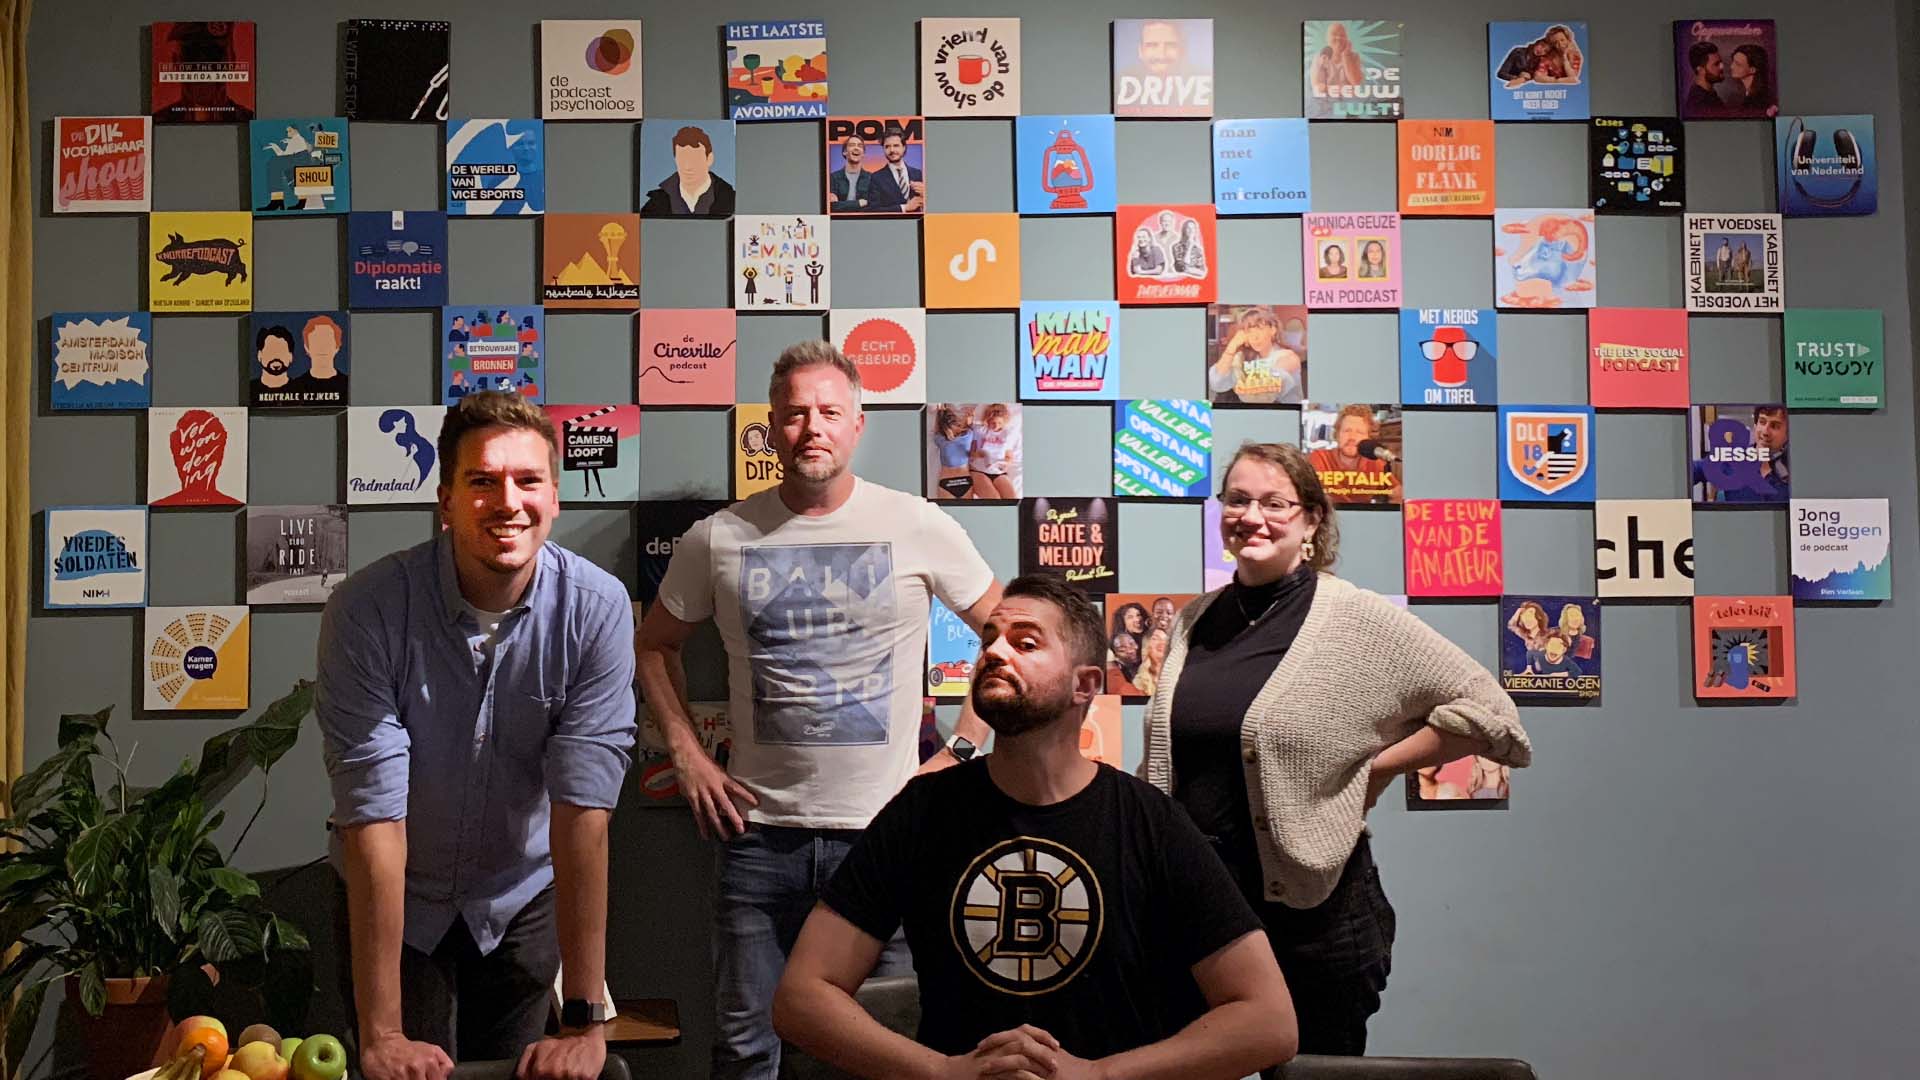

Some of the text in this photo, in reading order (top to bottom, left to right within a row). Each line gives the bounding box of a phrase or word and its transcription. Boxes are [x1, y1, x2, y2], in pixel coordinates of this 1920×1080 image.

[730, 23, 824, 38] HET LAATSTE
[935, 27, 1010, 109] vriend van de show
[1365, 67, 1400, 81] DE
[550, 75, 568, 87] de
[550, 87, 612, 101] podcast
[1117, 75, 1212, 105] DRIVE
[1313, 84, 1400, 98] LEEUW
[550, 98, 635, 112] psycholoog
[733, 104, 826, 119] AVONDMAAL
[1333, 102, 1400, 116] LULT!
[1595, 119, 1624, 127] Cases
[84, 122, 123, 145] DIK
[829, 120, 923, 141] POM
[1220, 128, 1256, 138] man
[317, 134, 336, 146] SIDE
[62, 141, 145, 160] VOORMEKAAR
[1220, 149, 1252, 160] met
[1412, 145, 1481, 161] OORLOG
[1798, 155, 1856, 165] Universiteit
[452, 165, 516, 175] DE WERELD
[1221, 168, 1240, 180] de
[1791, 166, 1864, 176] van Nederland
[60, 152, 146, 207] show
[299, 172, 329, 184] SHOW
[452, 178, 474, 187] VAN
[1416, 172, 1477, 190] FLANK
[452, 190, 524, 200] VICE SPORTS
[1222, 188, 1307, 201] microfoon
[1308, 215, 1396, 229] MONICA GEUZE
[1689, 218, 1777, 230] HET VOEDSEL
[354, 261, 442, 277] Diplomatie
[1690, 233, 1701, 293] KABINET
[1767, 234, 1778, 293] KABINET
[375, 276, 421, 290] raakt!
[545, 286, 638, 299] neutrale kijkers
[1309, 289, 1398, 303] FAN PODCAST
[1691, 296, 1778, 308] HET VOEDSEL
[1036, 310, 1106, 334] MAN
[1419, 309, 1478, 324] MET NERDS
[61, 337, 136, 348] AMSTERDAM
[682, 335, 694, 343] de
[1032, 332, 1110, 357] man
[469, 345, 517, 353] BETROUWBARE
[654, 343, 725, 359] Cineville
[861, 341, 896, 352] ECHT
[1594, 347, 1685, 358] THE BEST SOCIAL
[1797, 342, 1856, 357] TRUST
[89, 350, 144, 360] MAGISCH
[849, 353, 912, 365] GEBEURD
[61, 363, 119, 373] CENTRUM
[473, 360, 513, 371] BRONNEN
[670, 362, 707, 371] podcast
[1035, 355, 1107, 380] MAN
[1603, 358, 1678, 372] PODCAST
[1795, 360, 1874, 376] NOBODY
[259, 392, 340, 402] NEUTRALE KIJKERS
[1424, 389, 1476, 404] OM TAFEL
[1516, 423, 1545, 442] DLC
[568, 435, 614, 445] CAMERA
[1130, 414, 1204, 468] OPSTAAN
[568, 448, 604, 458] LOOPT
[1119, 433, 1196, 481] VALLEN &
[1709, 447, 1770, 462] JESSE
[350, 477, 416, 492] Podnataal
[1407, 502, 1496, 521] DE EEUW
[1798, 508, 1840, 524] Jong
[280, 518, 314, 536] LIVE
[1039, 523, 1104, 543] GAITE &
[1799, 523, 1882, 539] Beleggen
[1409, 523, 1489, 547] VAN DE
[63, 536, 126, 553] VREDES
[1813, 544, 1848, 552] podcast
[279, 549, 315, 566] RIDE
[1039, 546, 1104, 567] MELODY
[54, 552, 137, 576] SOLDATEN
[1412, 547, 1502, 588] AMATEUR
[289, 567, 305, 576] FAST
[187, 663, 213, 671] vragen
[1504, 677, 1600, 690] VIERKANTE OGEN
[992, 871, 1063, 958] B
